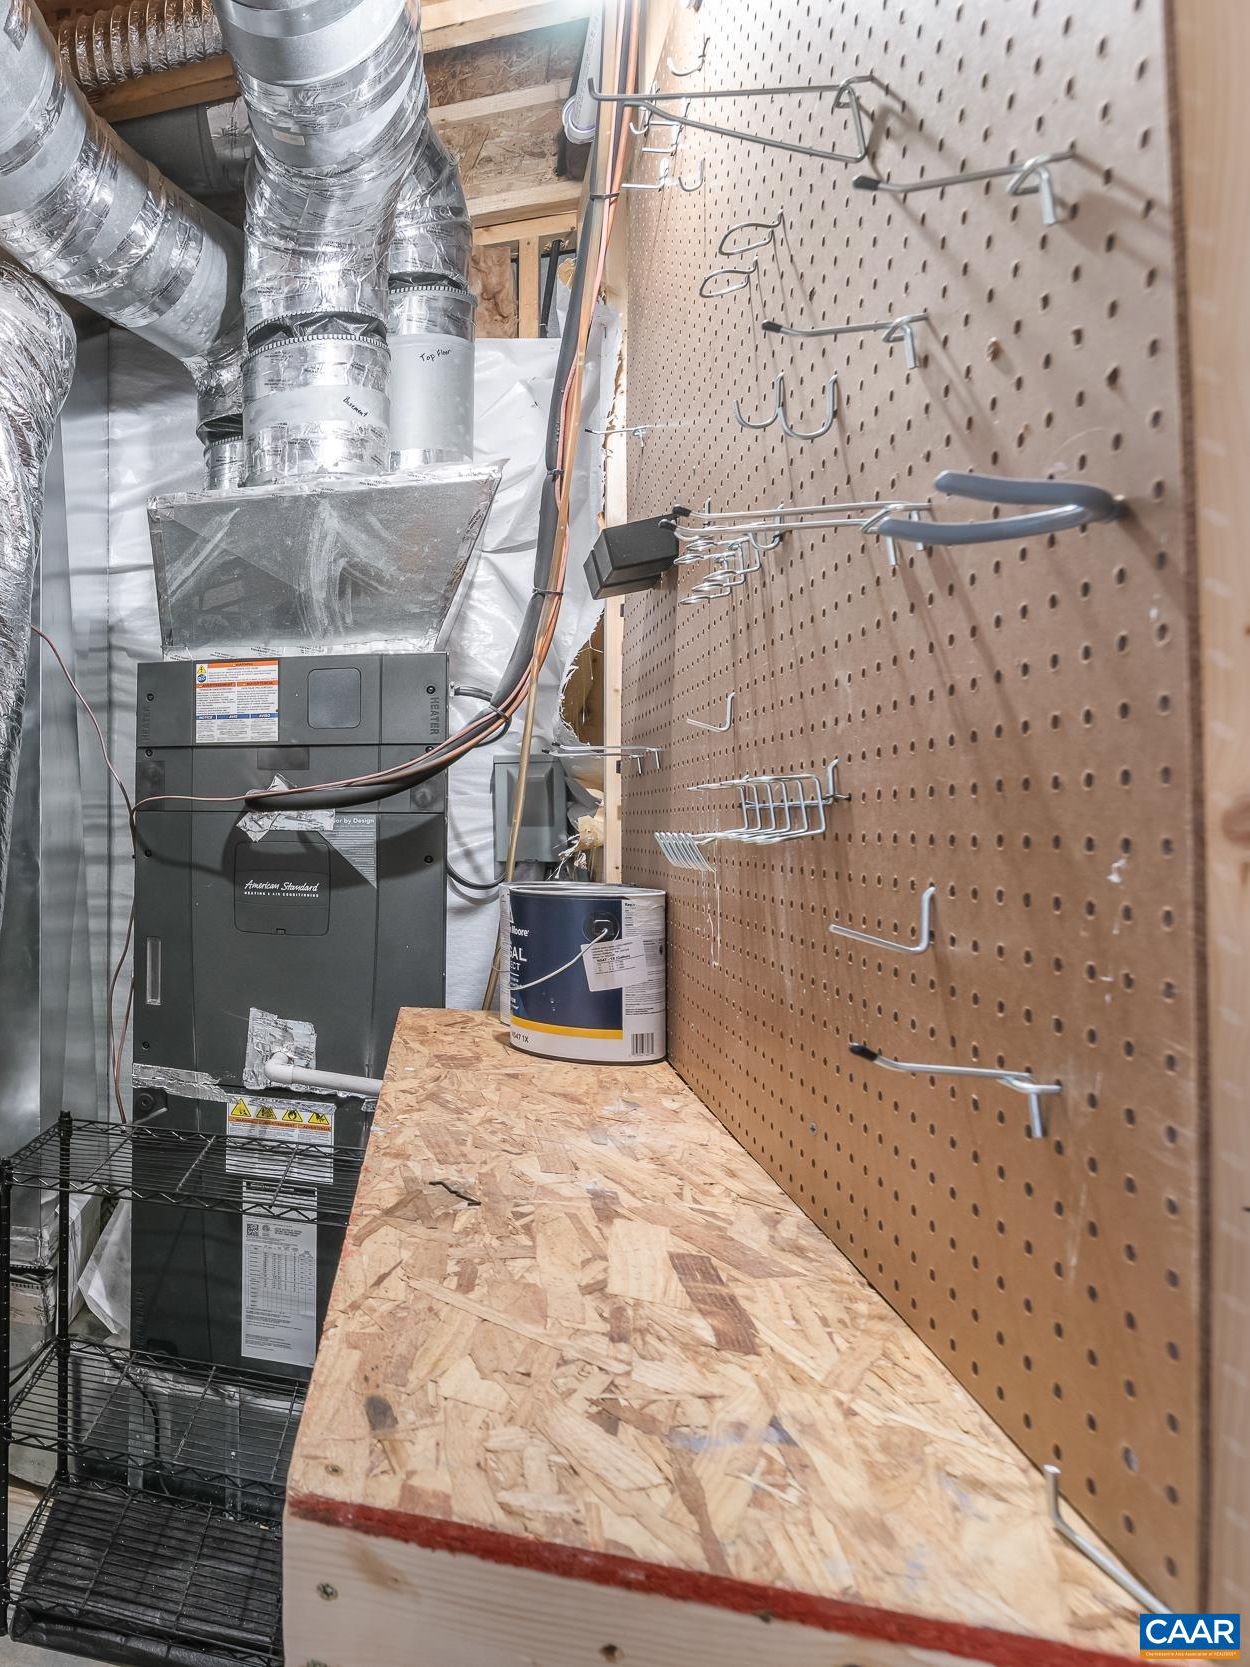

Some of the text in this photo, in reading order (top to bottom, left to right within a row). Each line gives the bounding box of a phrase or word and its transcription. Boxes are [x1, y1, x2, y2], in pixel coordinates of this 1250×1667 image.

[420, 353, 436, 362] Top
[430, 697, 439, 735] HEATER
[244, 880, 320, 891] American Standard
